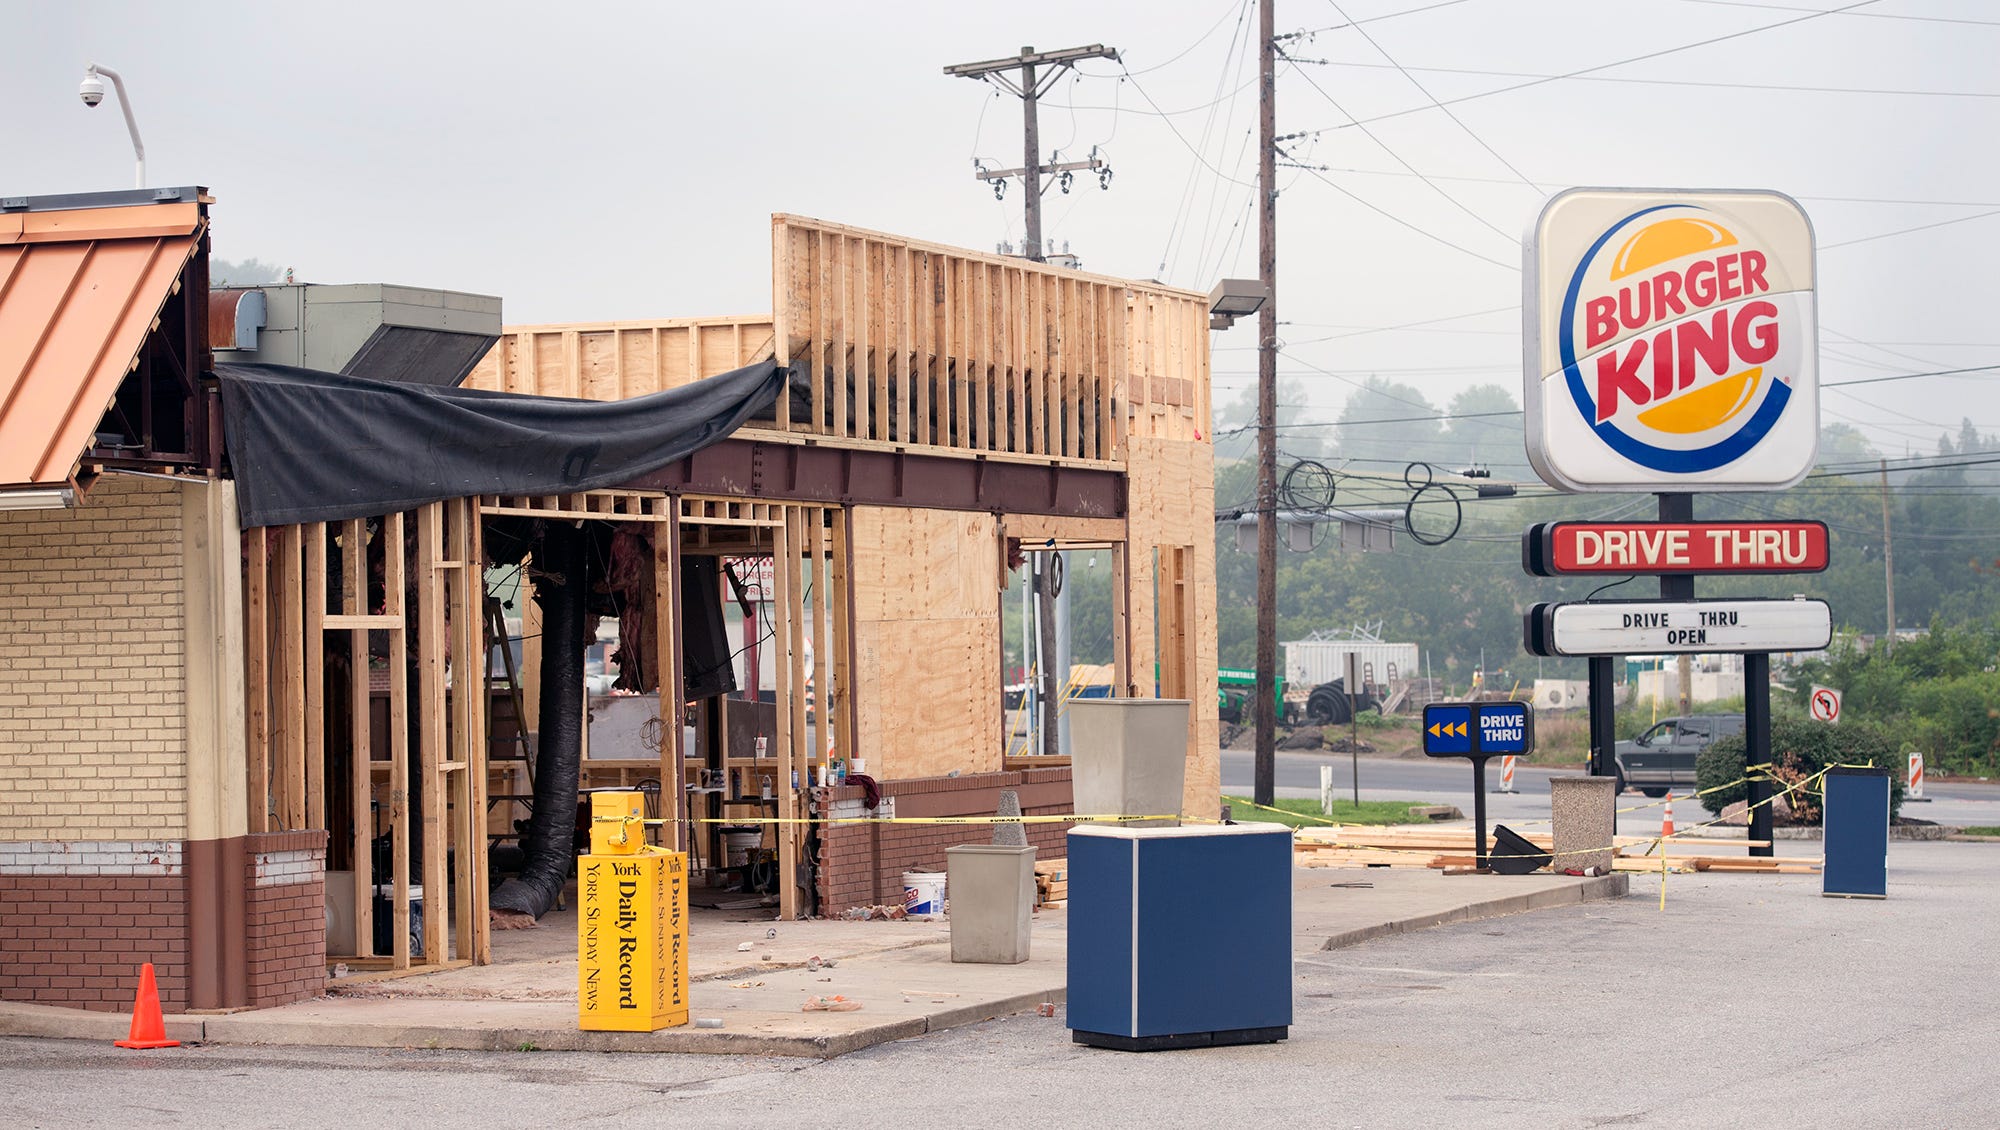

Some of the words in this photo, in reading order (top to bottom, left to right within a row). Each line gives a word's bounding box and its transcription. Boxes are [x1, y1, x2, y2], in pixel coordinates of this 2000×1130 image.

[1585, 250, 1770, 350] BURGER
[1596, 301, 1779, 423] KING
[1575, 530, 1690, 565] DRIVE
[1706, 529, 1807, 565] THRU
[1623, 612, 1669, 628] DRIVE
[1699, 611, 1738, 626] THRU
[1667, 630, 1706, 645] OPEN
[1480, 715, 1524, 728] DRIVE
[1484, 729, 1522, 742] THRU
[587, 863, 600, 902] YORK
[611, 863, 642, 876] York
[615, 880, 637, 933] Daily
[587, 907, 600, 963] SUNDAY
[587, 968, 600, 1011] NEWS
[618, 936, 637, 1010] Record
